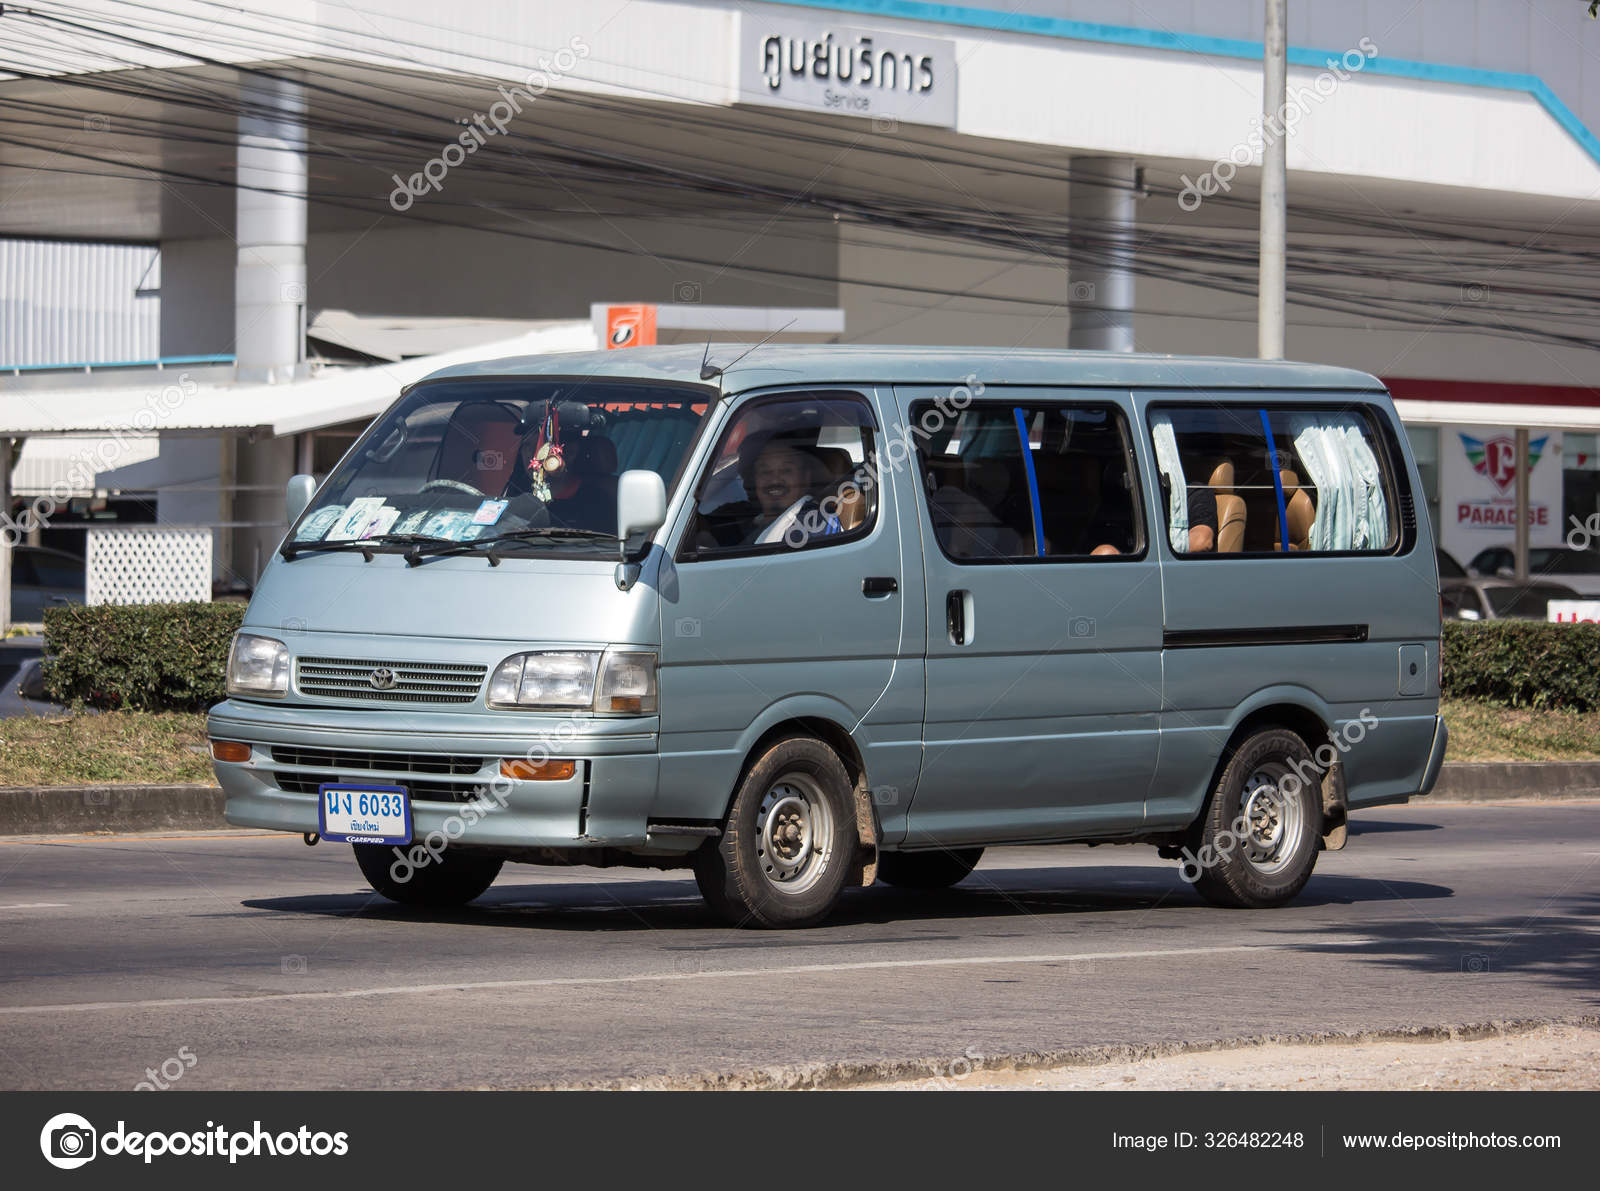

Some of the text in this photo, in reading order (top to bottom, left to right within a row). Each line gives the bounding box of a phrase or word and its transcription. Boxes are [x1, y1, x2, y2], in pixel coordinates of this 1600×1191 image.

[763, 32, 933, 92] ศูนย์บริการ
[823, 89, 872, 111] Service
[1457, 504, 1549, 526] PARADSE
[359, 794, 402, 817] 6033
